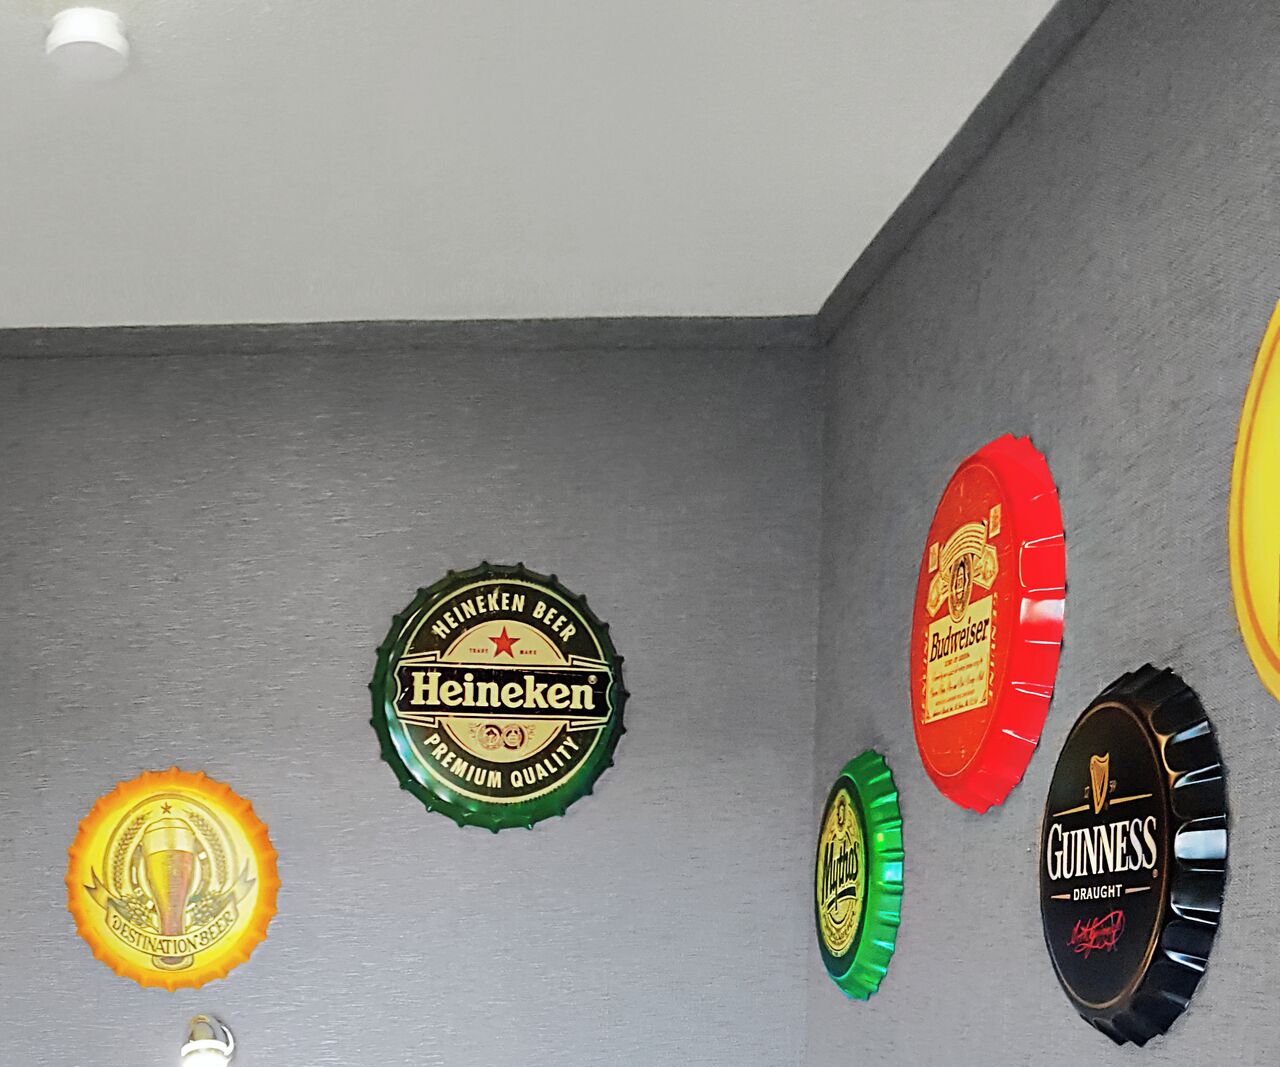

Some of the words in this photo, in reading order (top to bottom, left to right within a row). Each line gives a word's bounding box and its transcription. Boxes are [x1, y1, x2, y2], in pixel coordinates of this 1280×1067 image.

[431, 592, 526, 640] HEINEKEN
[532, 601, 578, 642] BEER
[929, 616, 990, 663] Budweiser
[410, 671, 596, 710] Heineken
[424, 733, 503, 789] PREMIUM
[510, 736, 581, 789] QUALITY
[1046, 815, 1158, 881] GUINNESS
[821, 840, 860, 911] Mythos
[1073, 884, 1123, 901] DRAUGHT
[112, 914, 198, 954] DESTINATION
[195, 911, 235, 946] BEER
